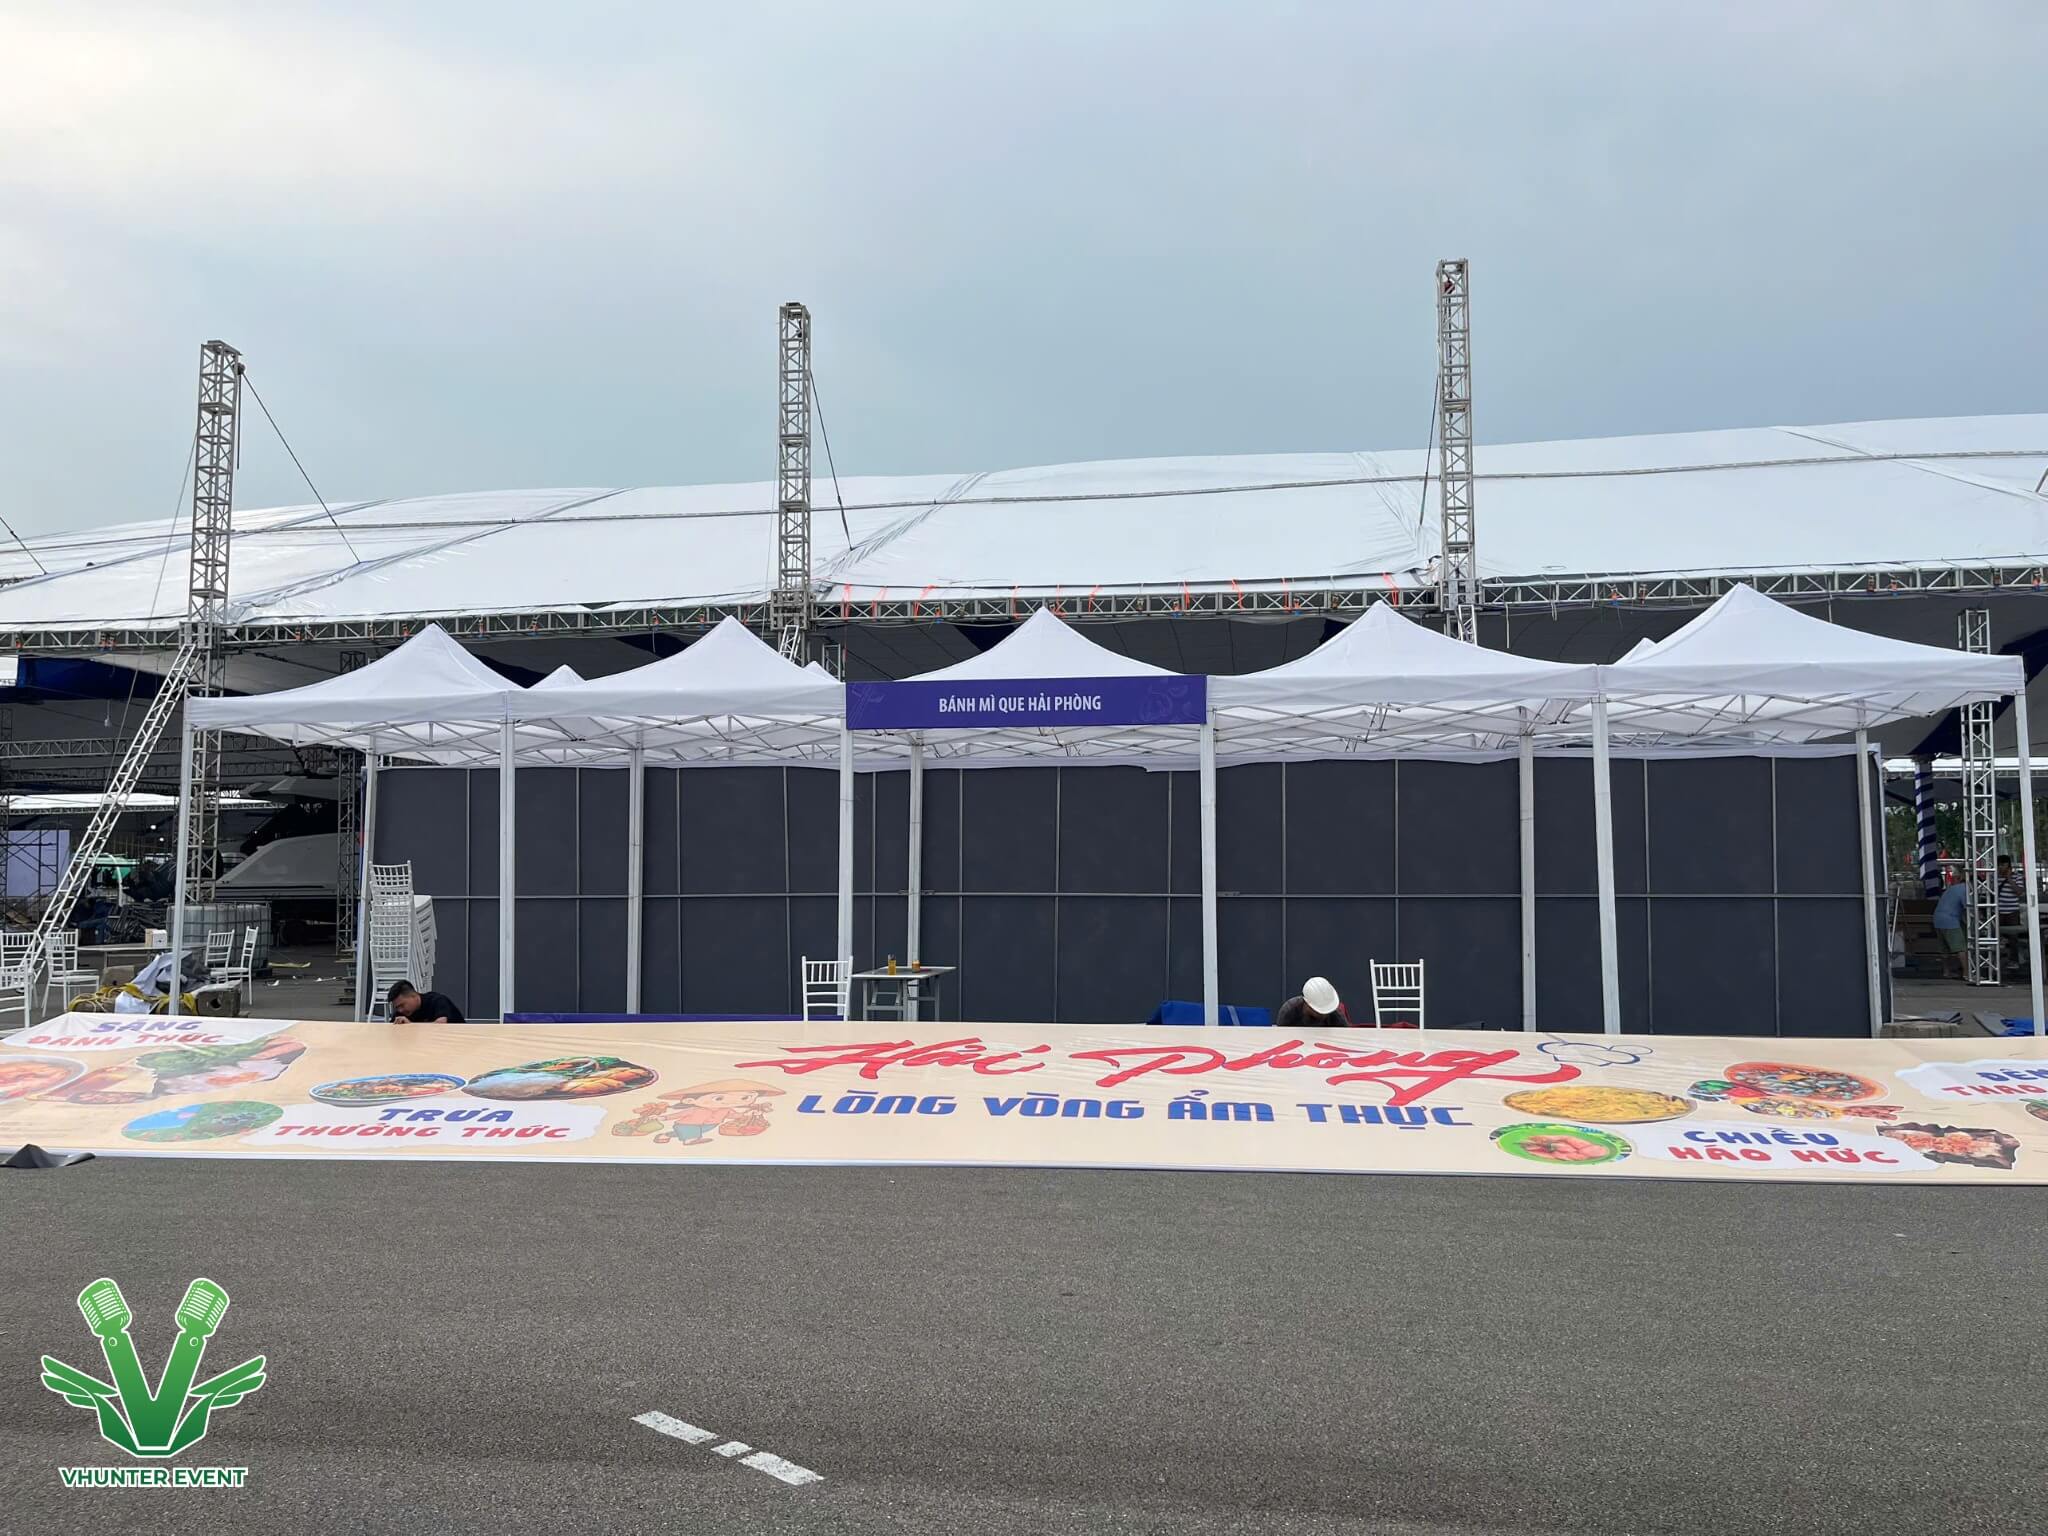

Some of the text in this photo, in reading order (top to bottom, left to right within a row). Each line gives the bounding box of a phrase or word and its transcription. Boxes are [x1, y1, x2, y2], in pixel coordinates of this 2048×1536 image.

[939, 692, 1102, 713] BÁNH MÌ QUE HẢI PHÒNG
[1068, 1040, 1581, 1106] Phòng
[1941, 1084, 2047, 1096] THAO
[379, 1107, 513, 1122] TRƯA
[797, 1089, 1472, 1130] LÒNG VÒNG ẨM THỰC
[275, 1122, 571, 1138] THƯỞNG THỨC
[1683, 1127, 1840, 1146] CHIỀU
[1668, 1144, 1900, 1164] HÁO HỨC
